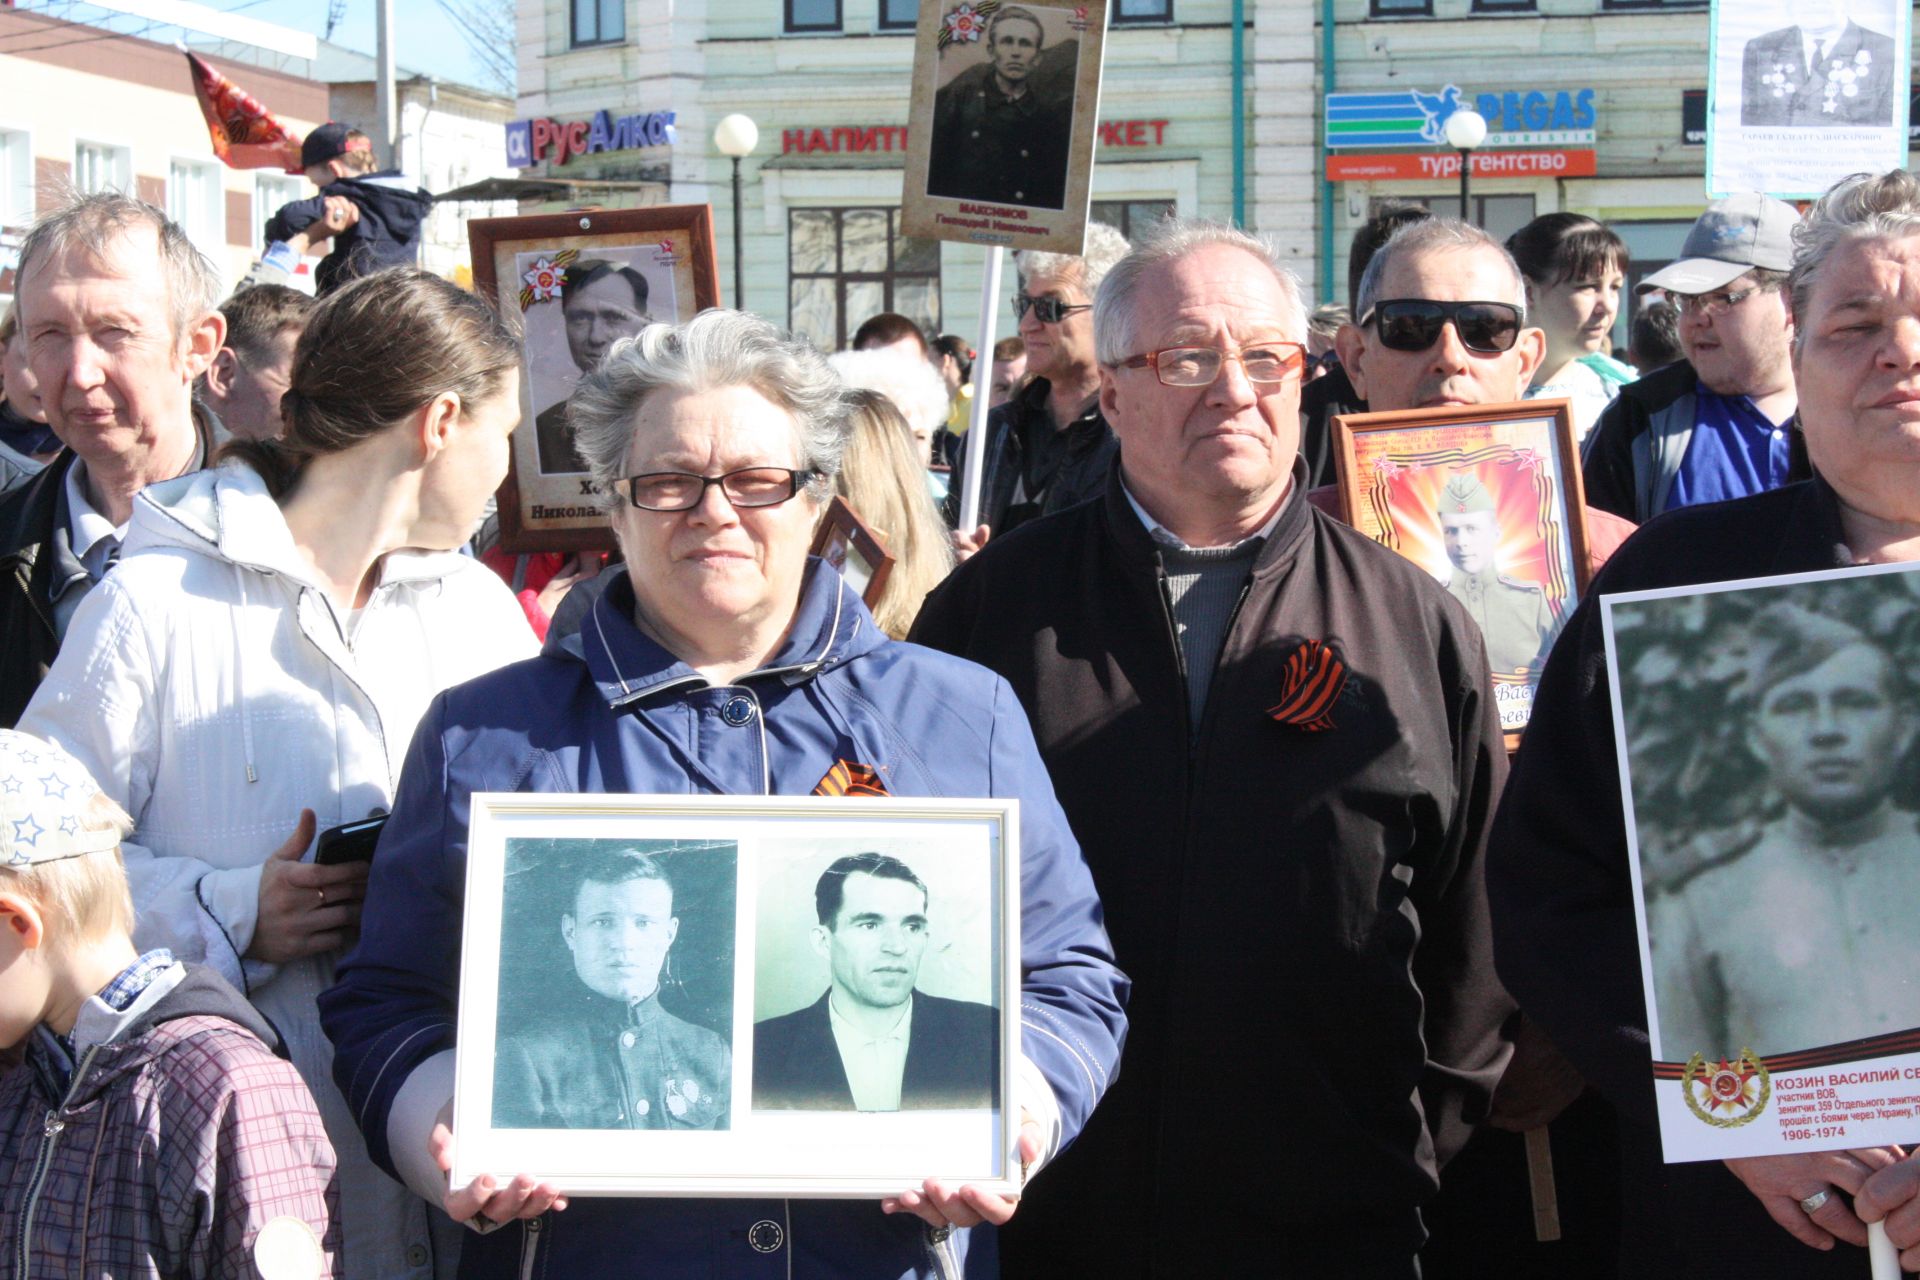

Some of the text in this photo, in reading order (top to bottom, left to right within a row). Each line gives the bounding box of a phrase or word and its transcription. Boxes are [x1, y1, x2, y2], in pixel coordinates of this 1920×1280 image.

[1476, 88, 1596, 131] PEGAS
[782, 120, 1169, 153] НАПИТ КЕТ
[531, 505, 608, 519] Никола
[1775, 1076, 1825, 1090] КОЗИН
[1829, 1067, 1900, 1086] ВАСИЛИЙ
[1776, 1088, 1838, 1105] участник ВОВ,
[1778, 1104, 1815, 1115] зенитчик
[1818, 1101, 1833, 1112] 359
[1834, 1098, 1886, 1110] Отдельного
[1779, 1114, 1812, 1127] прошёл
[1814, 1115, 1820, 1123] с
[1821, 1111, 1848, 1123] боями
[1850, 1110, 1875, 1122] через
[1876, 1107, 1914, 1120] Украину,
[1781, 1126, 1846, 1141] 1906-1974
